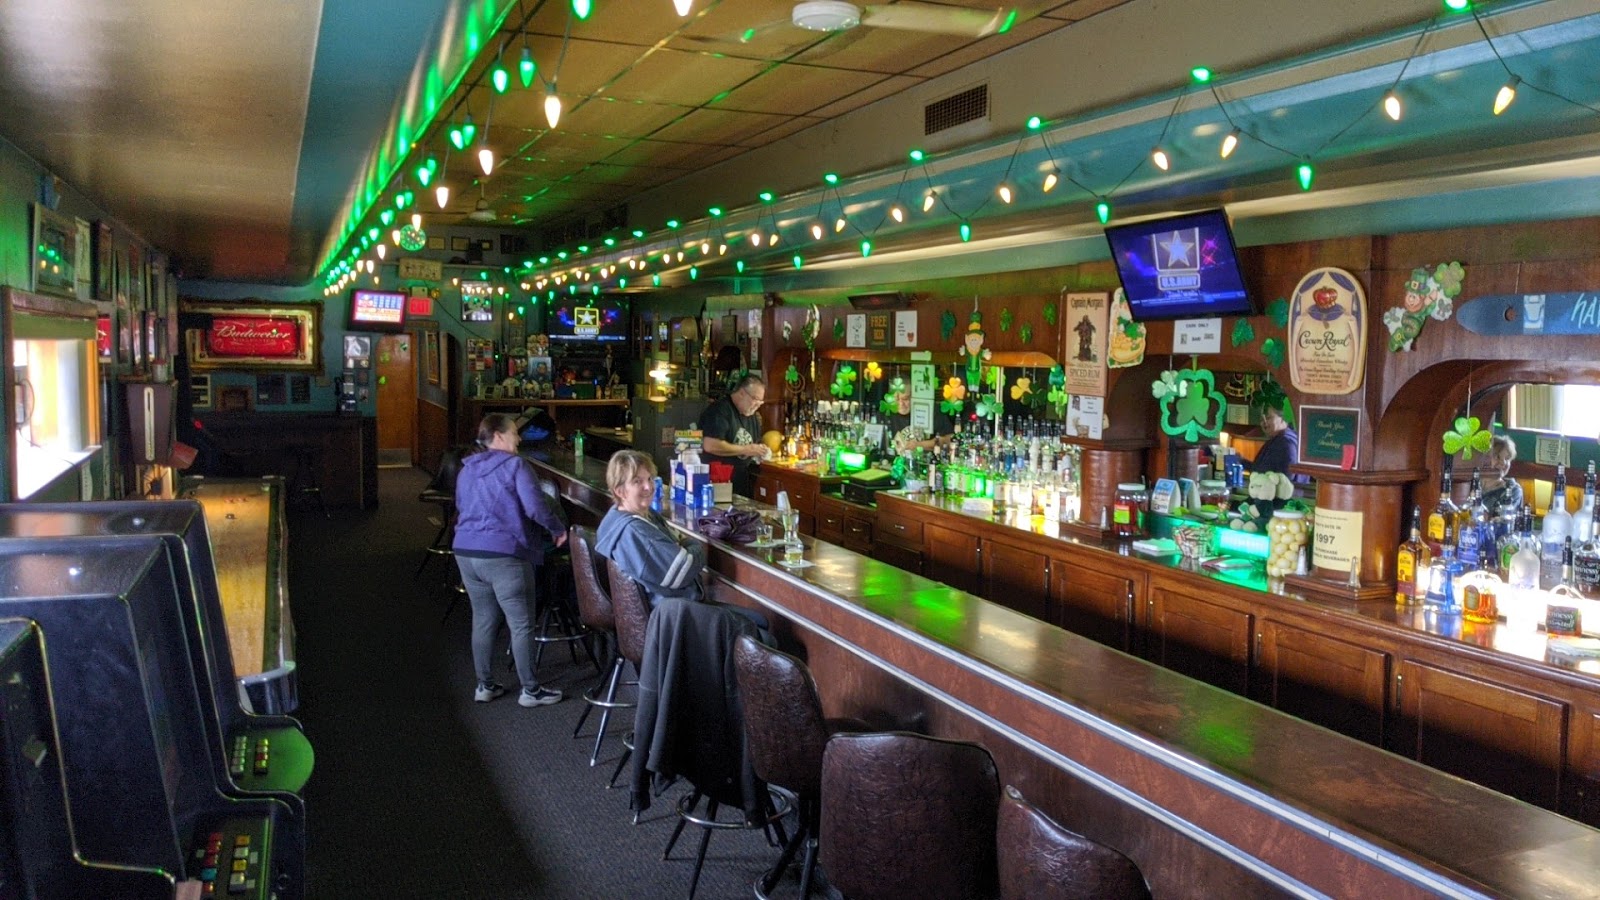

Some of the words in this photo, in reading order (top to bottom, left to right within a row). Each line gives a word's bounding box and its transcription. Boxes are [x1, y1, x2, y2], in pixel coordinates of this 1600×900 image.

[1071, 297, 1086, 309] Captain
[1087, 298, 1104, 310] Morgan
[870, 315, 887, 328] FREE
[217, 325, 291, 339] Budweiser
[1299, 330, 1323, 349] Crown
[1315, 331, 1351, 351] Royal
[1070, 368, 1087, 377] SPICED
[1088, 369, 1100, 378] RUM
[1316, 533, 1335, 545] 1997
